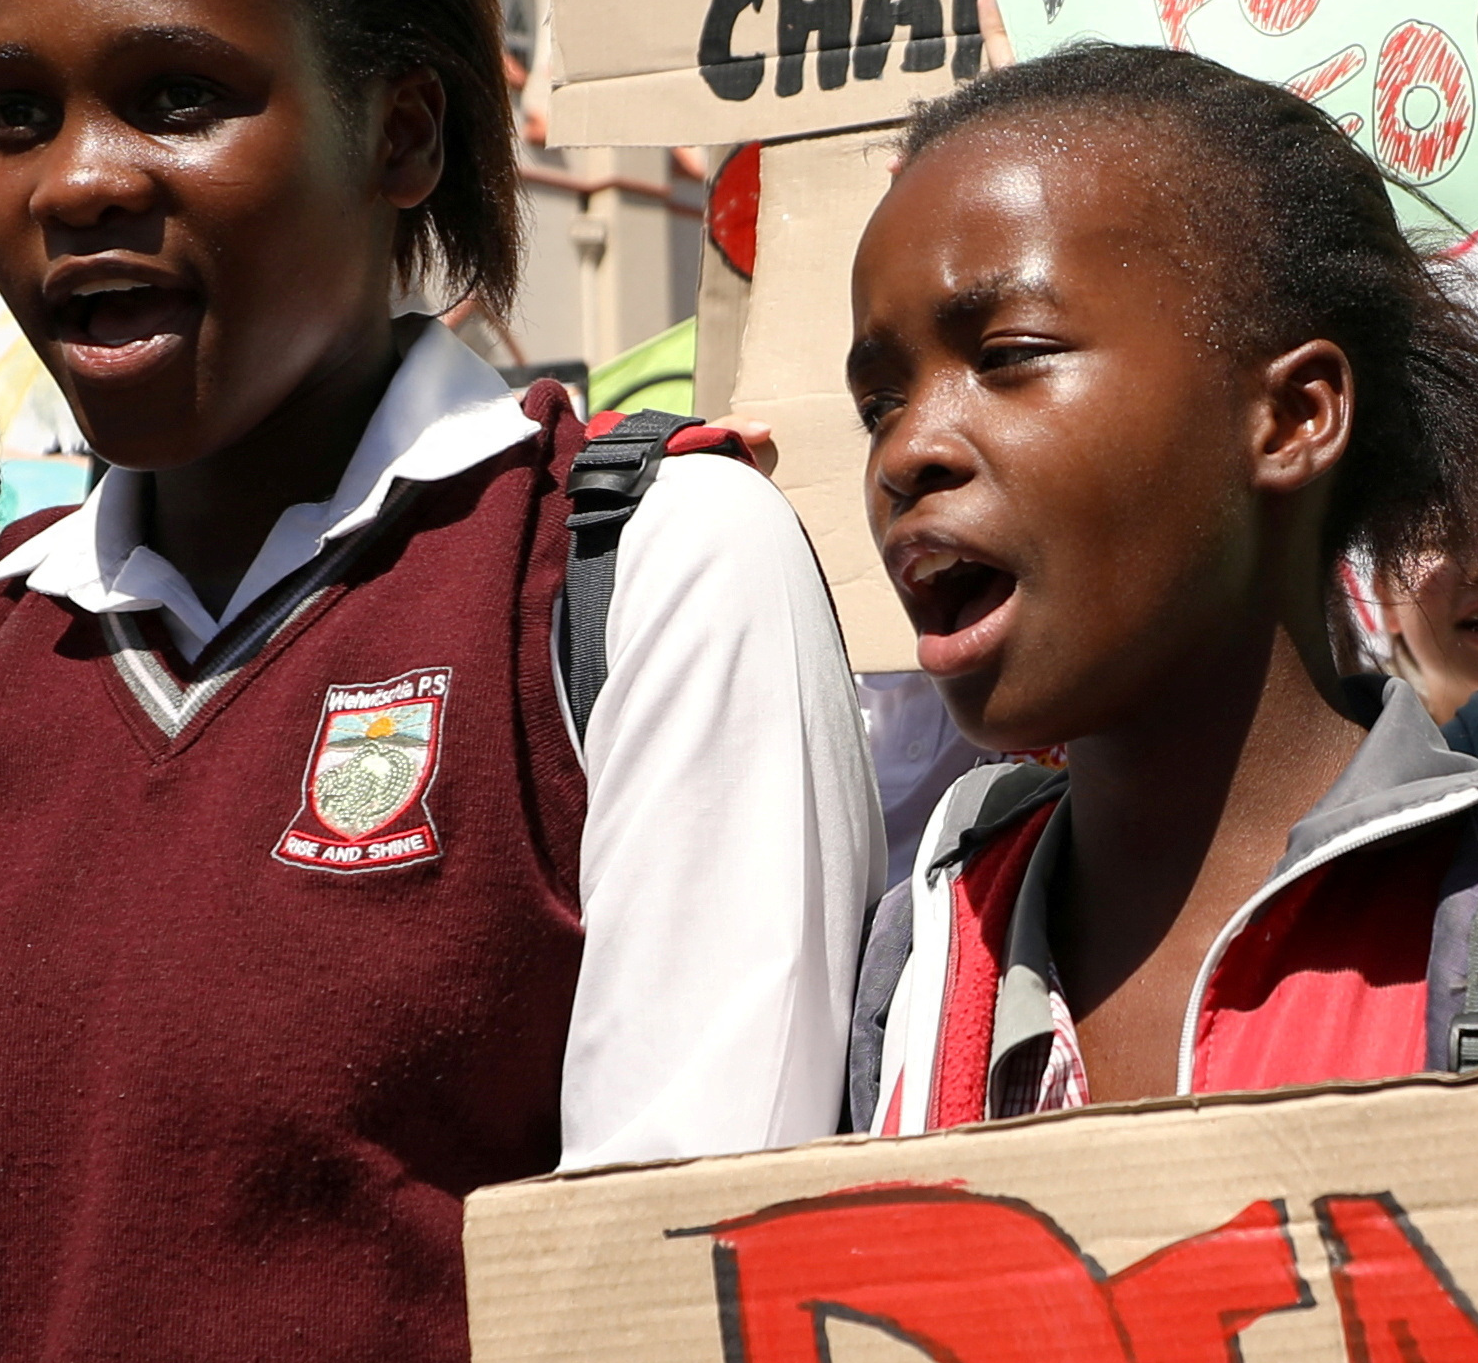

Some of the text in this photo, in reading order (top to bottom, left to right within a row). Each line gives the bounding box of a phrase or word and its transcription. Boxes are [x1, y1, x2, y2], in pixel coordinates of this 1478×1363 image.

[284, 833, 426, 863] RISE AND SHINE
